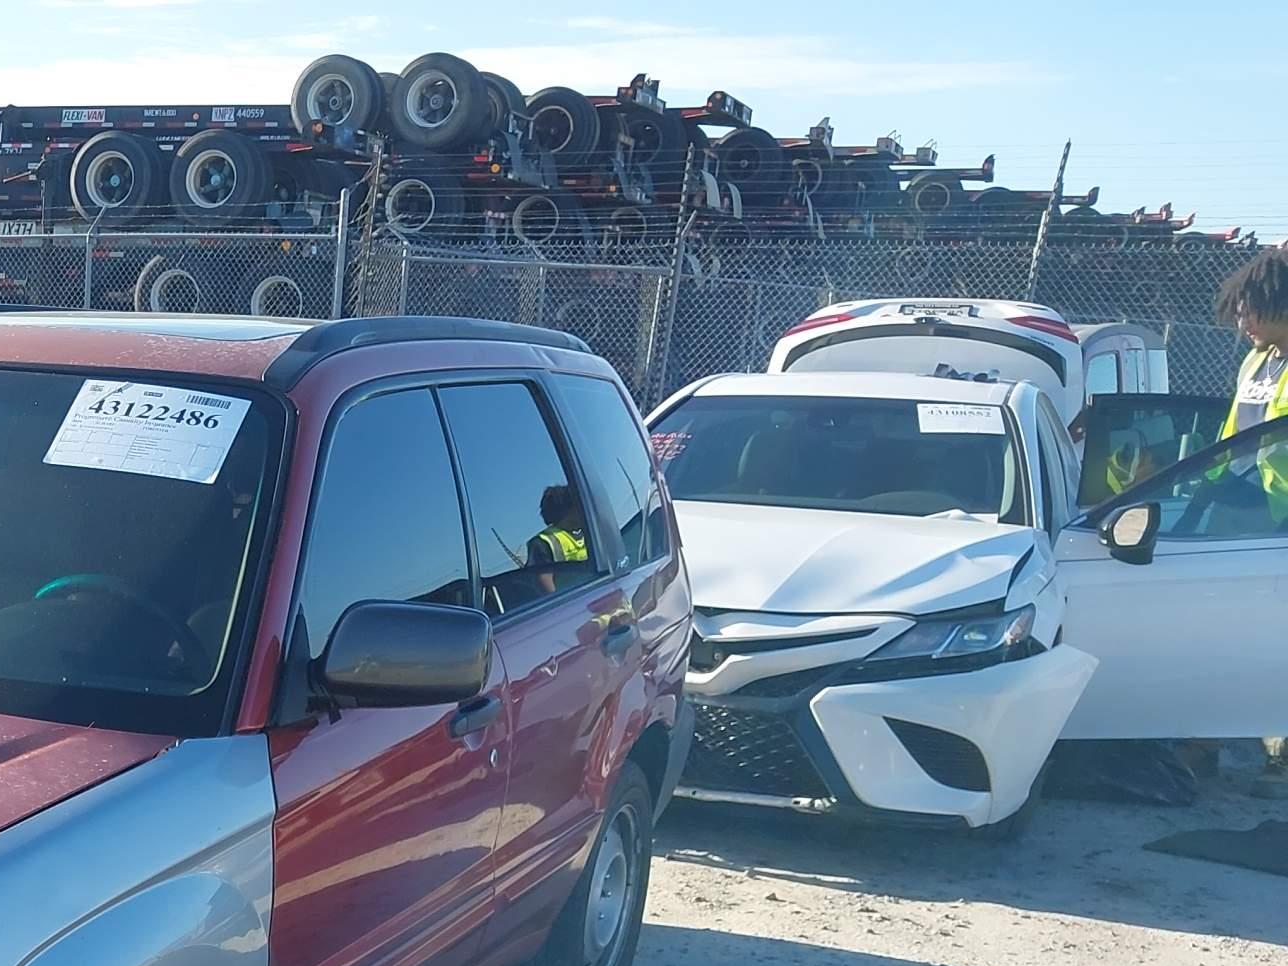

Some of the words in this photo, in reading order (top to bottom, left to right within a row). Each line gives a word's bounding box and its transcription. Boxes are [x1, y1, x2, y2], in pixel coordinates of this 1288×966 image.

[63, 110, 105, 122] FLEXI-VAN
[236, 109, 265, 119] 440559
[88, 399, 223, 429] 43122486
